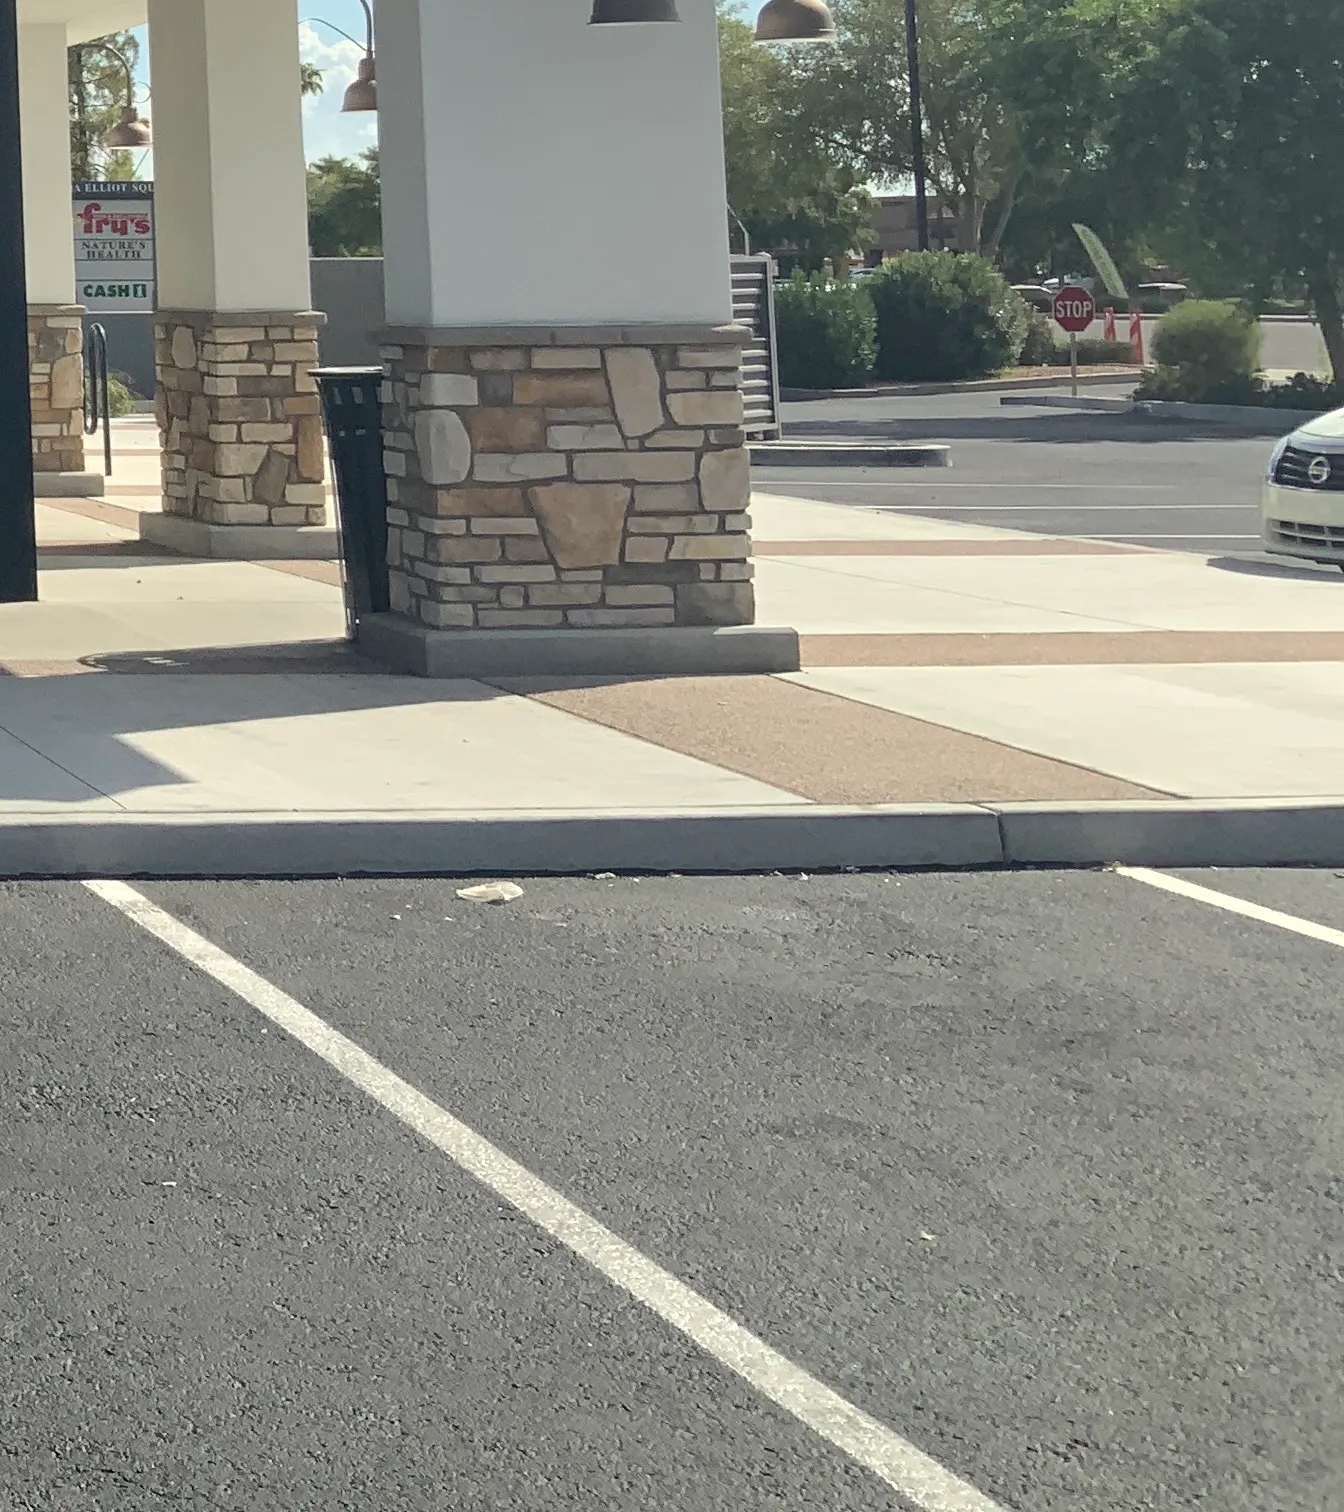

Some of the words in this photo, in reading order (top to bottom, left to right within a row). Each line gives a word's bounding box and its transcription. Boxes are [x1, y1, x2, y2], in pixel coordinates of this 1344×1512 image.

[84, 183, 127, 193] ELLIOT
[78, 202, 151, 236] fry's
[81, 241, 146, 251] NATURE'S
[86, 250, 142, 259] HEALTH
[82, 284, 130, 298] CASH
[1055, 300, 1093, 318] STOP
